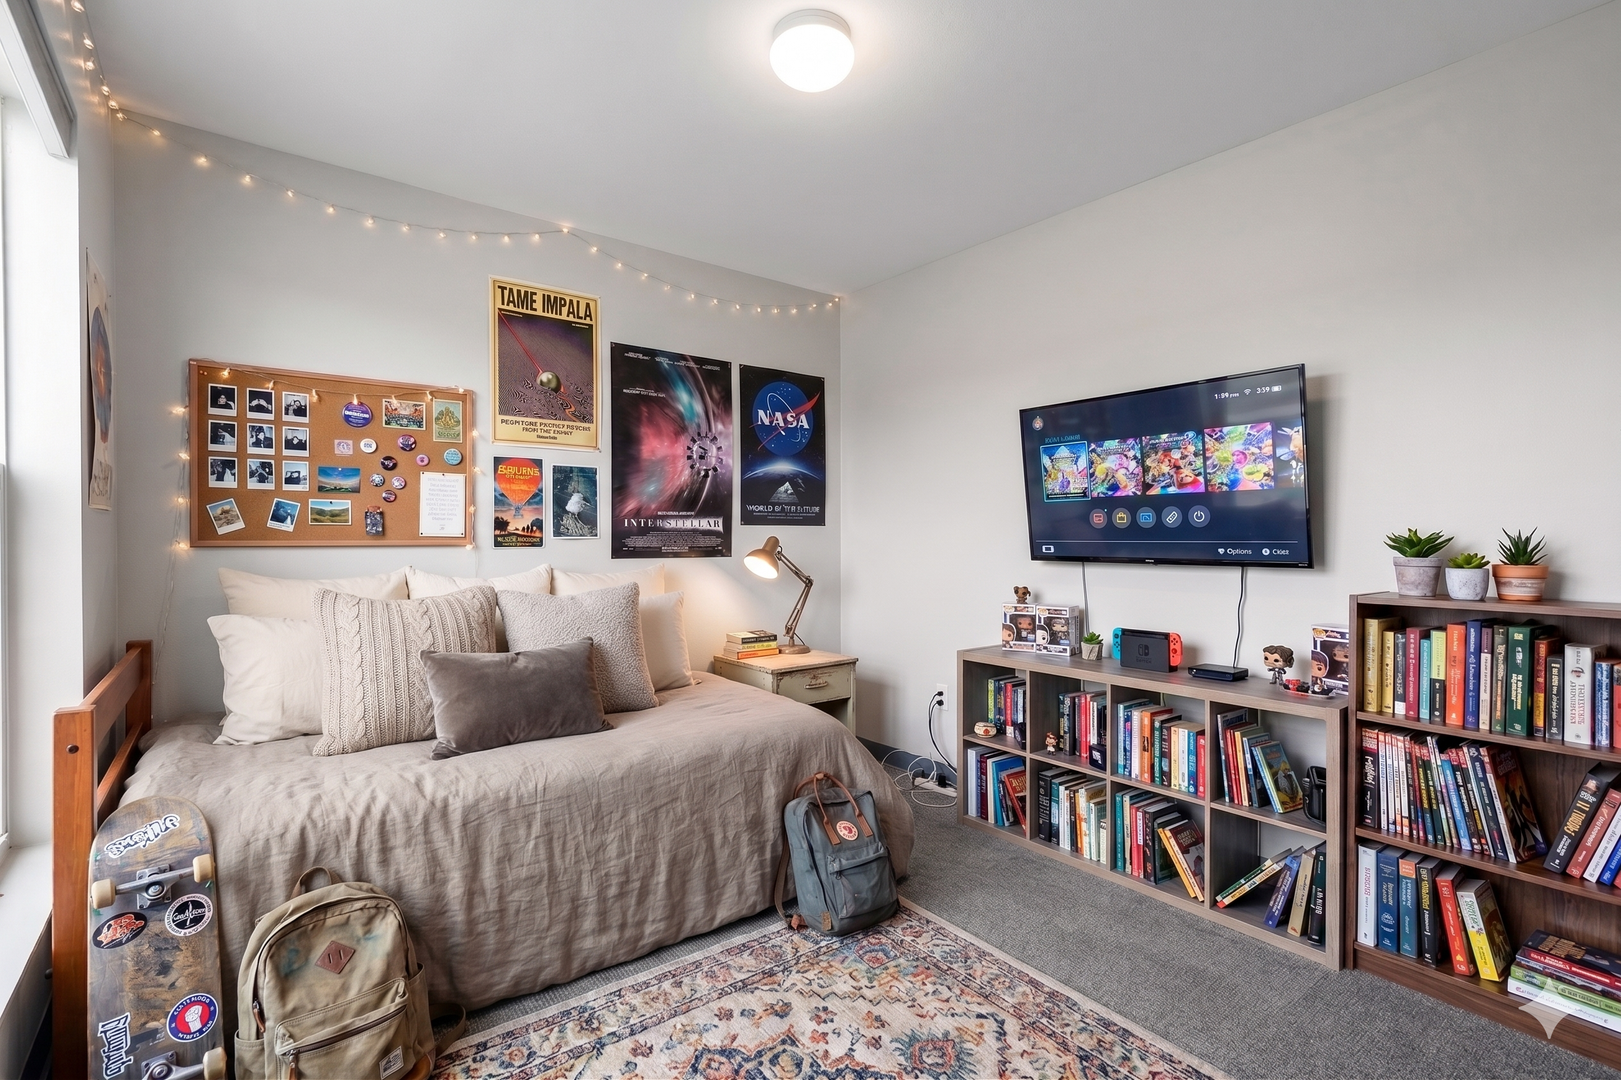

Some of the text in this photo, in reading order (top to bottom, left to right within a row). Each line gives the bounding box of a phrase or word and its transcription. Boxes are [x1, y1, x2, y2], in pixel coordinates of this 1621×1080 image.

[497, 285, 593, 322] TAME IMPALA
[757, 409, 810, 429] NASA
[624, 518, 720, 528] INTERSTELLAR
[1226, 548, 1252, 556] Options
